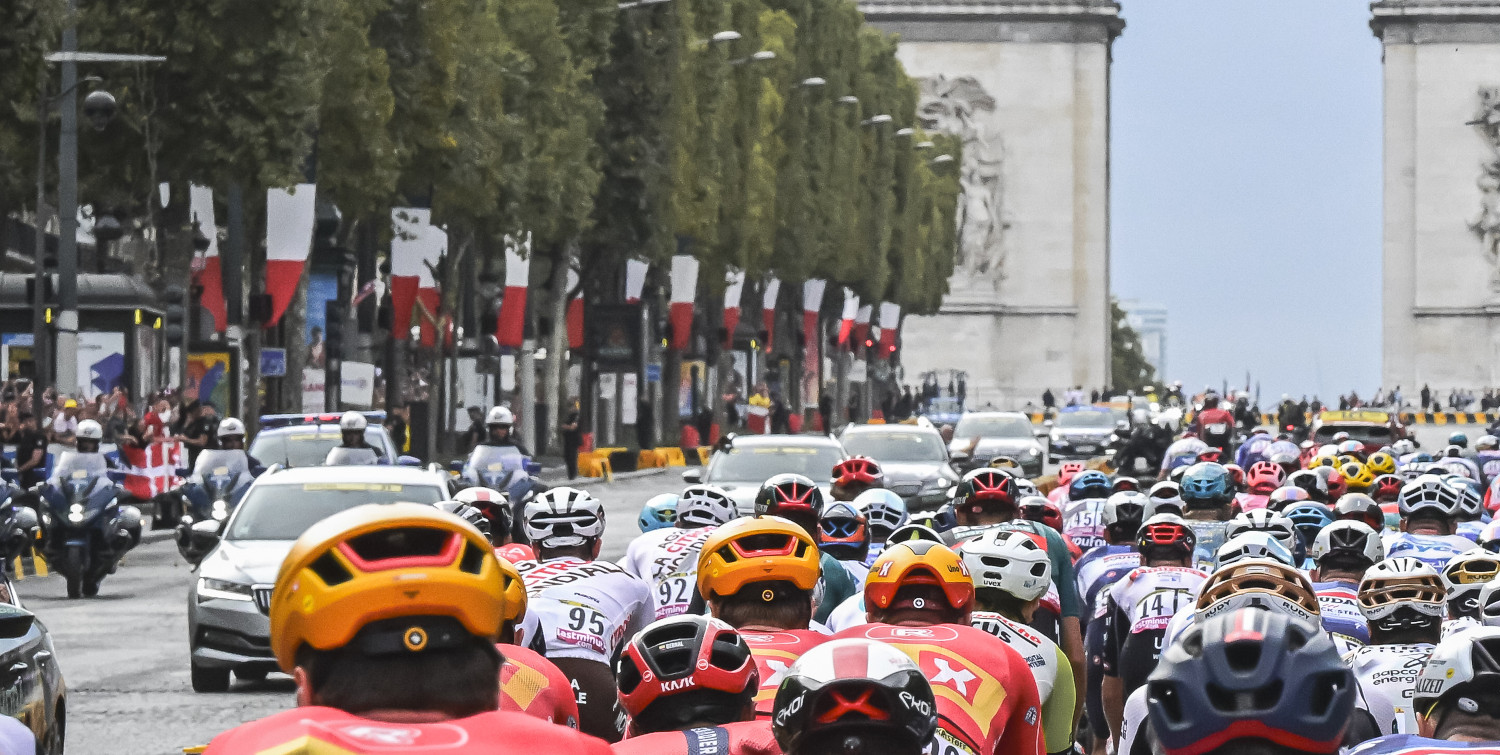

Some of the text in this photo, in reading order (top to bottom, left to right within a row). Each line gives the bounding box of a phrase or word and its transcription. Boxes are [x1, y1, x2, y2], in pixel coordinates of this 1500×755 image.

[659, 578, 688, 606] 92
[1205, 600, 1231, 619] RUDY
[1282, 601, 1310, 620] RUDY
[568, 607, 605, 636] 95
[665, 640, 684, 650] BERNAL
[661, 676, 695, 692] KASK
